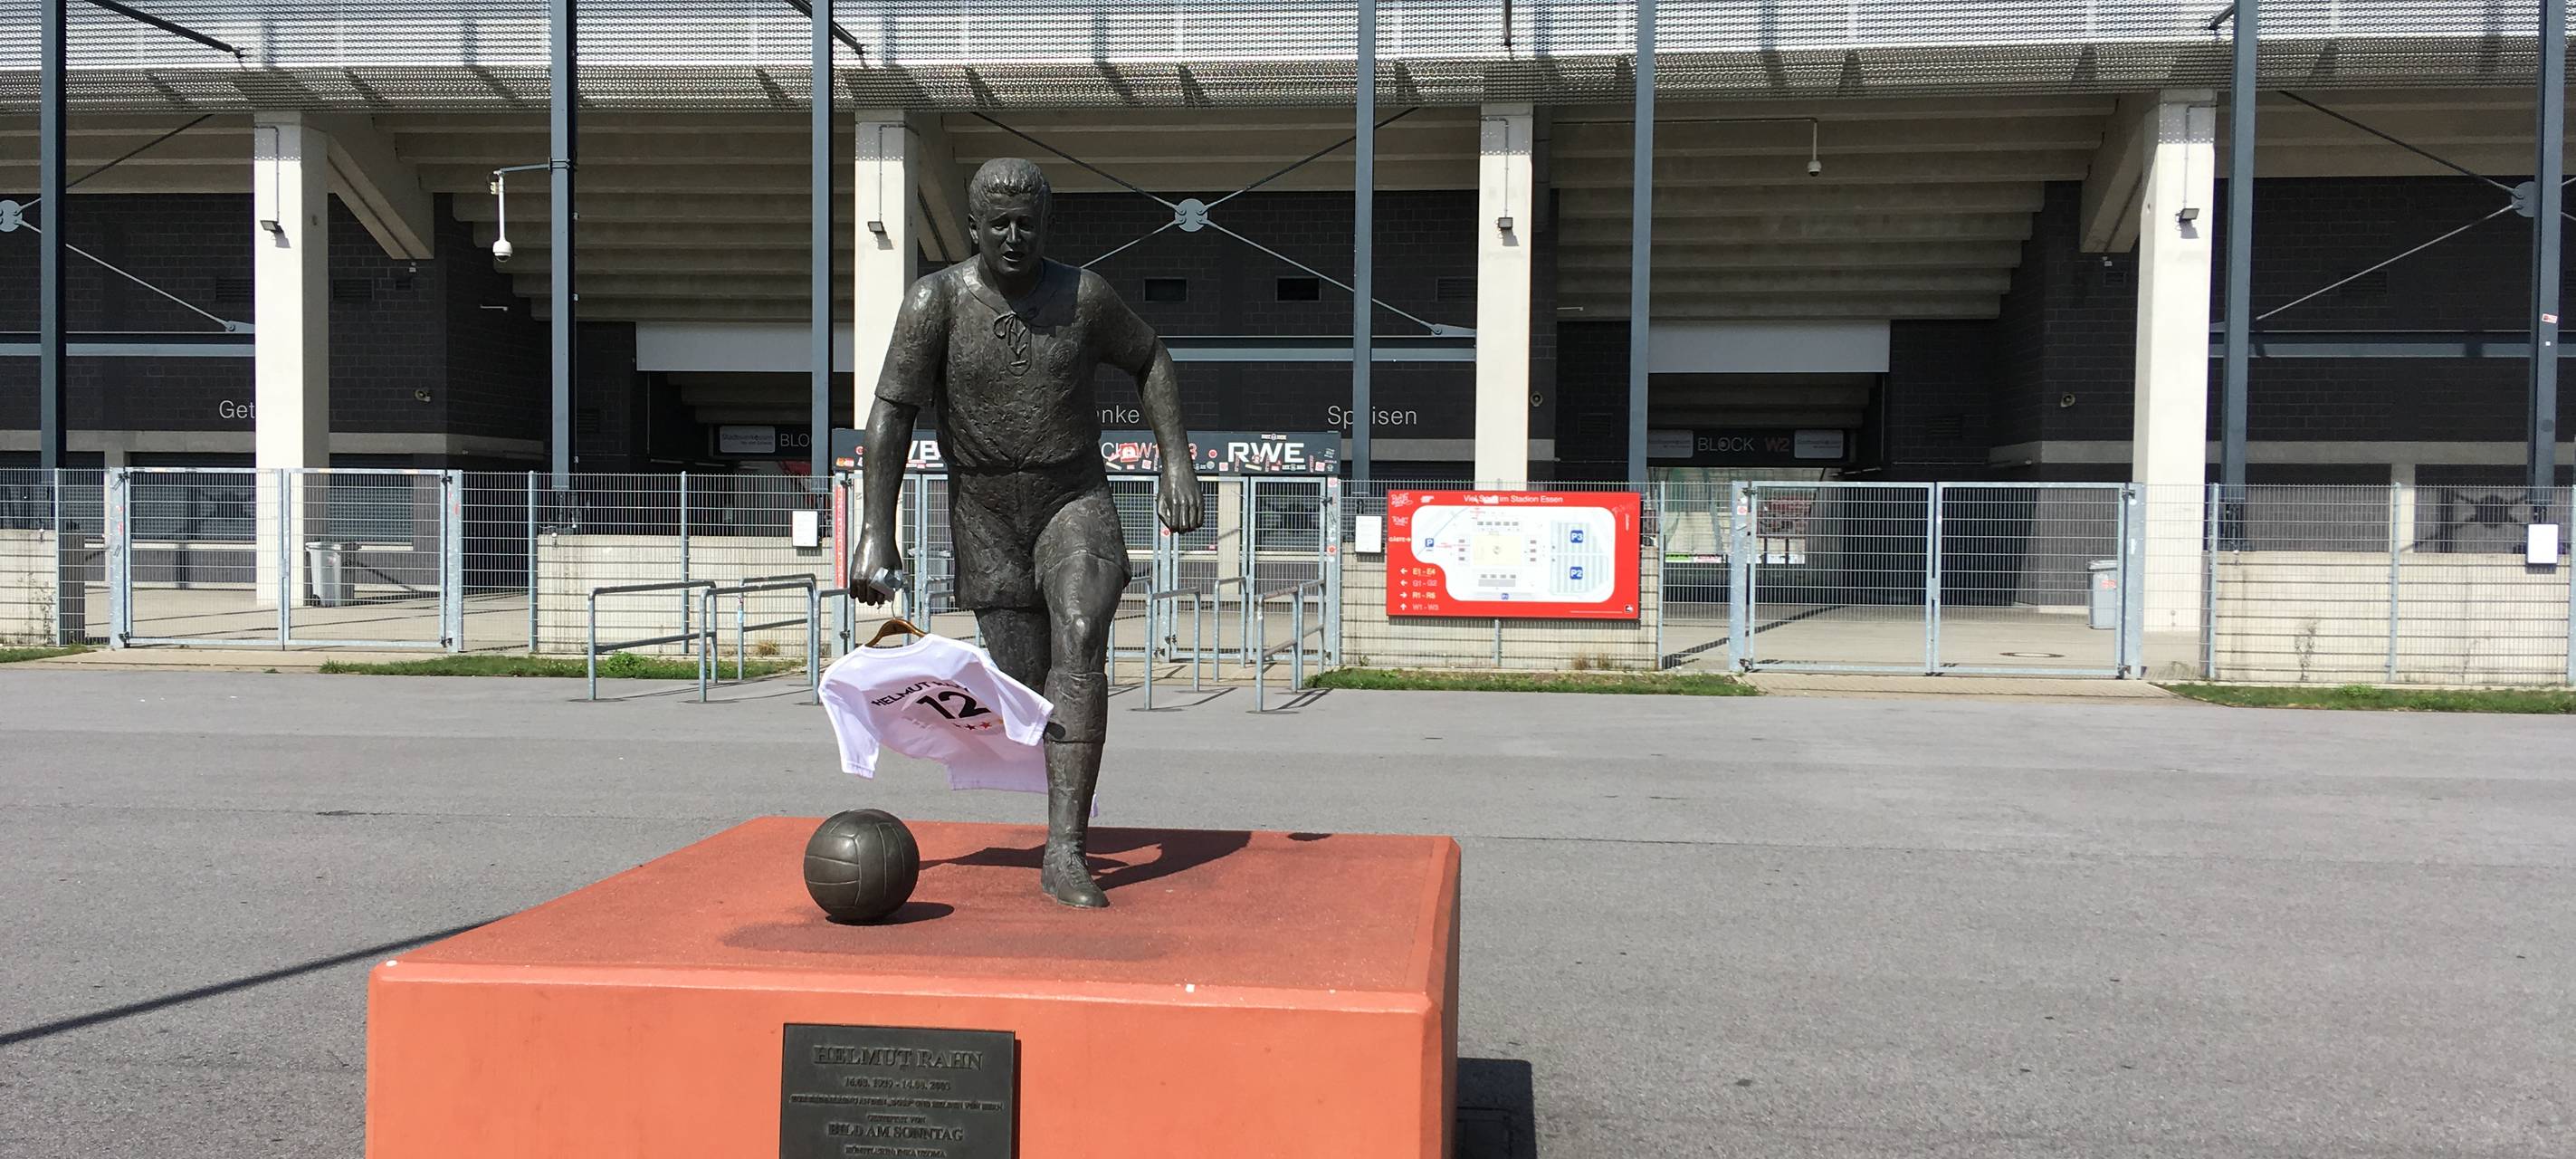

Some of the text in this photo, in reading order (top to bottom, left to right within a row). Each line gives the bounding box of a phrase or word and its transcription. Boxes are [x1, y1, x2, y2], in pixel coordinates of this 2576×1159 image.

[1096, 406, 1140, 425] nke
[1327, 406, 1417, 429] Spisen
[780, 434, 812, 447] BLO
[1697, 437, 1754, 452] BLOCK
[1766, 438, 1789, 452] W2
[1227, 442, 1305, 464] RWE
[1510, 495, 1539, 503] Stadion
[1541, 495, 1563, 503] Essen
[871, 681, 930, 706] HELMUT
[916, 691, 992, 719] 12
[814, 1045, 983, 1070] HELMUT RAHN
[827, 1122, 964, 1141] BILD AM SONNTAG
